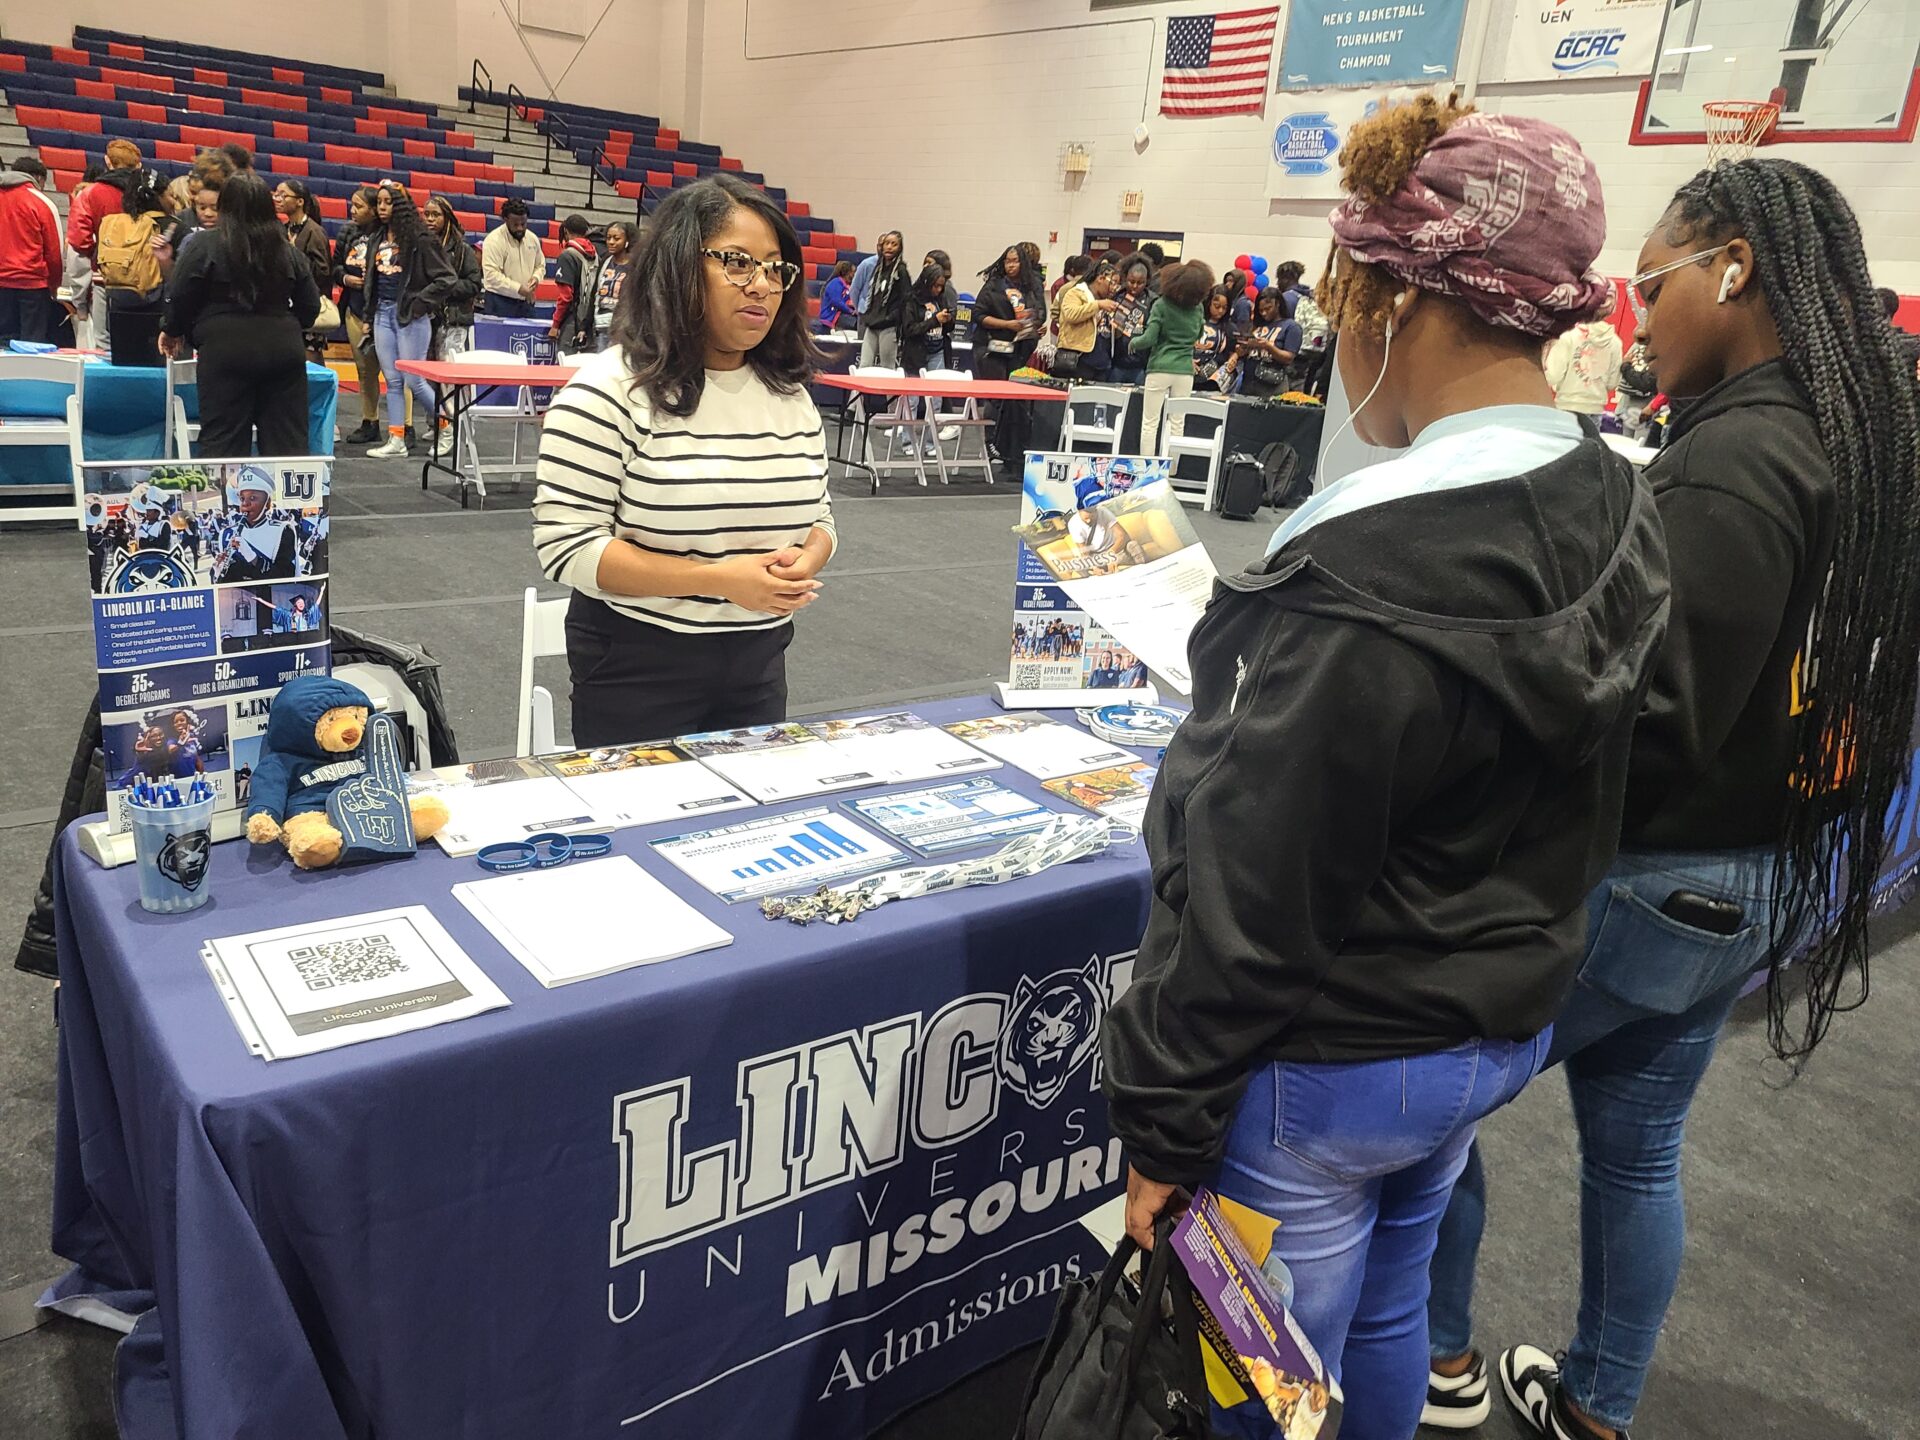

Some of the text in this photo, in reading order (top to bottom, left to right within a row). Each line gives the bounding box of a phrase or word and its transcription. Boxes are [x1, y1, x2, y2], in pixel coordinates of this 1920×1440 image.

[1322, 3, 1426, 26] MEN'S BASKETBALL
[1540, 10, 1572, 24] UEN
[1336, 29, 1404, 48] TOURNAMENT
[1555, 33, 1627, 59] GCAC
[1340, 54, 1392, 69] CHAMPION
[1288, 140, 1326, 149] BASKETBALL
[1292, 129, 1324, 141] GCAC
[1284, 148, 1328, 158] CHAMPIONSHIP
[1125, 193, 1138, 207] EXIT
[1046, 459, 1070, 483] LU
[281, 469, 317, 501] LU
[1052, 550, 1118, 572] Business
[1032, 587, 1047, 601] 35+
[102, 595, 205, 617] LINCOLN AT-A-GLANCE
[110, 621, 128, 629] Small
[110, 631, 142, 639] Dedicated
[173, 624, 196, 632] support
[112, 649, 142, 658] Attractive
[154, 644, 184, 652] affordable
[112, 657, 137, 665] options
[295, 652, 312, 670] 11+
[1043, 666, 1073, 675] APPLY NOW!
[214, 662, 237, 681] 50+
[278, 670, 299, 683] SPORTS
[131, 673, 155, 694] 35+
[192, 675, 259, 695] CLUBS & ORGANIZATIONS
[115, 688, 171, 707] DEGREE PROGRAMS
[234, 696, 271, 720] LIN
[300, 756, 367, 787] LINCOL
[356, 813, 395, 845] LU
[926, 878, 955, 891] LINCOLN
[323, 994, 439, 1023] Lincoln University
[608, 1108, 1086, 1323] UNIVERS
[785, 1136, 1124, 1318] MISSOURI
[1195, 1210, 1239, 1277] DIVISION
[1241, 1286, 1280, 1345] SPORTS
[817, 1248, 1082, 1402] Admissions
[1192, 1290, 1241, 1358] OLARSHIP
[1199, 1320, 1250, 1384] ACADEMIC
